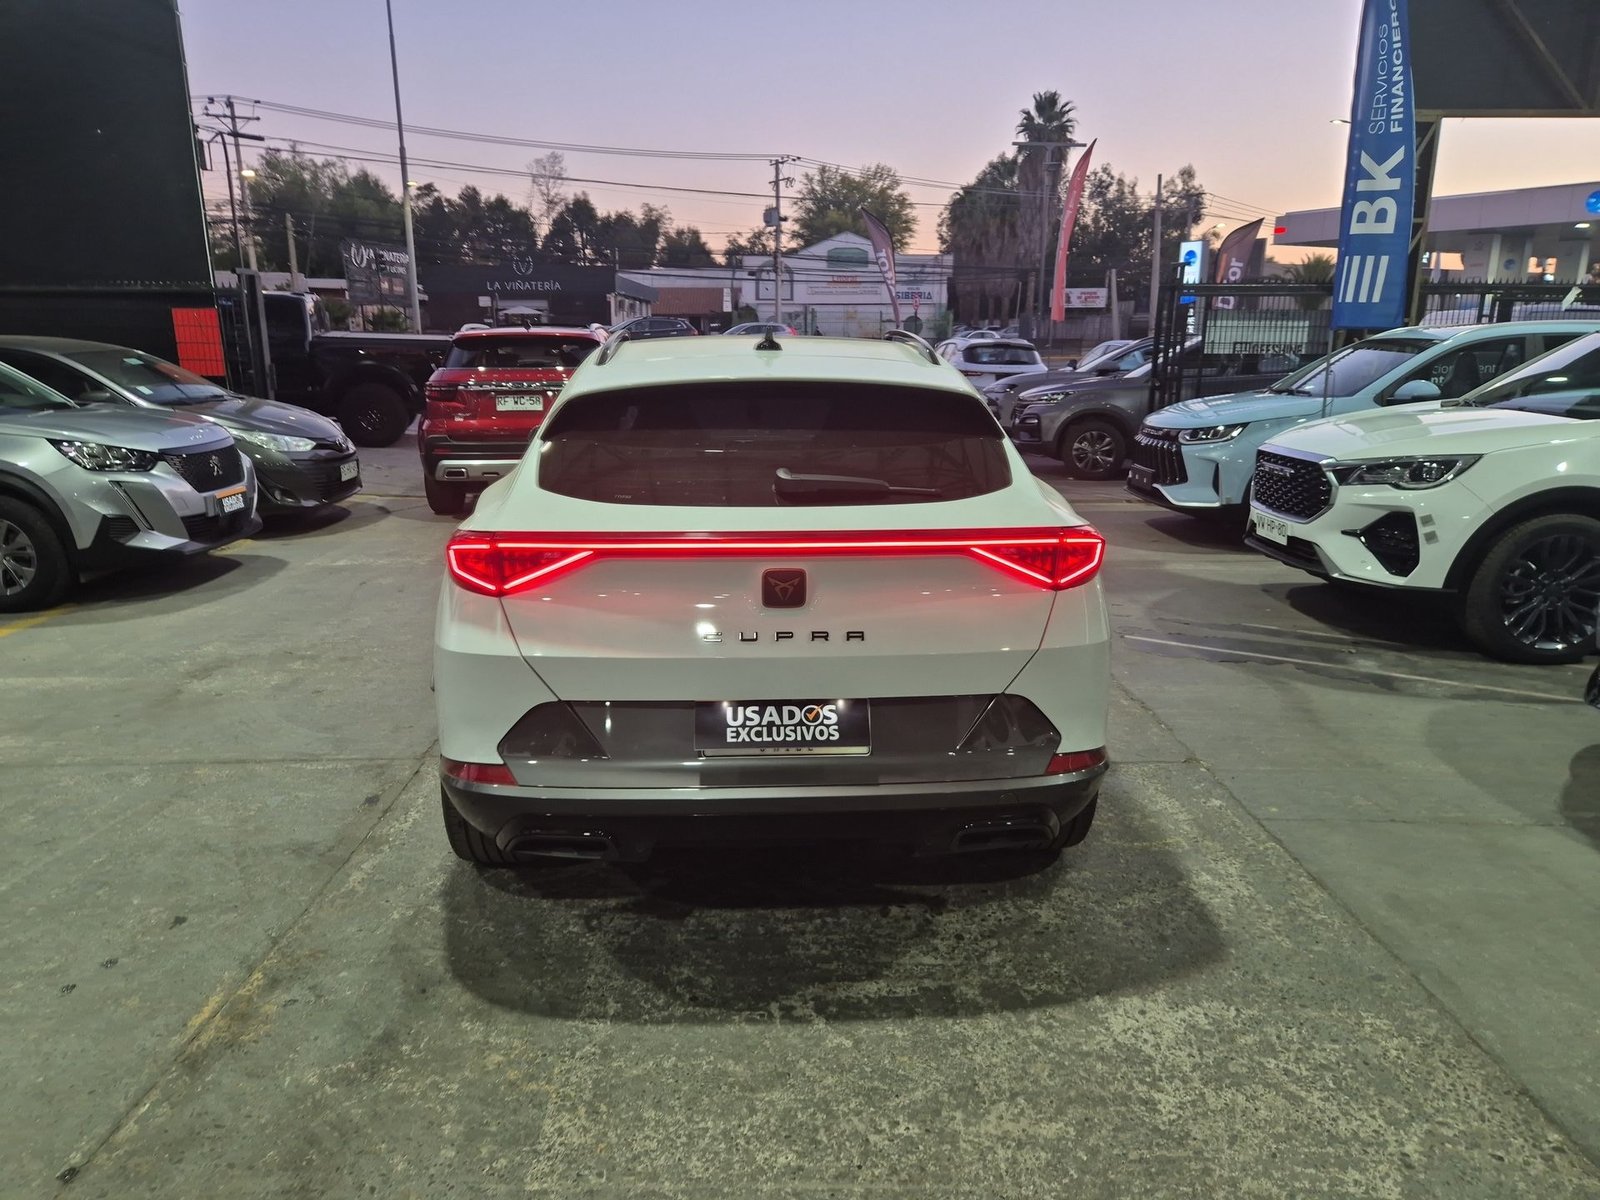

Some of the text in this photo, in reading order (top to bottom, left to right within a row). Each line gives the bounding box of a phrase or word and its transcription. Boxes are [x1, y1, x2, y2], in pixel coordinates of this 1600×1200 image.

[1368, 23, 1389, 134] SERVICIOS
[1349, 145, 1405, 235] BK
[486, 279, 562, 291] LA VIÑATERÍA
[703, 631, 865, 642] CUPRA
[726, 704, 838, 726] USADOS
[726, 726, 840, 742] EXCLUSIVOS
